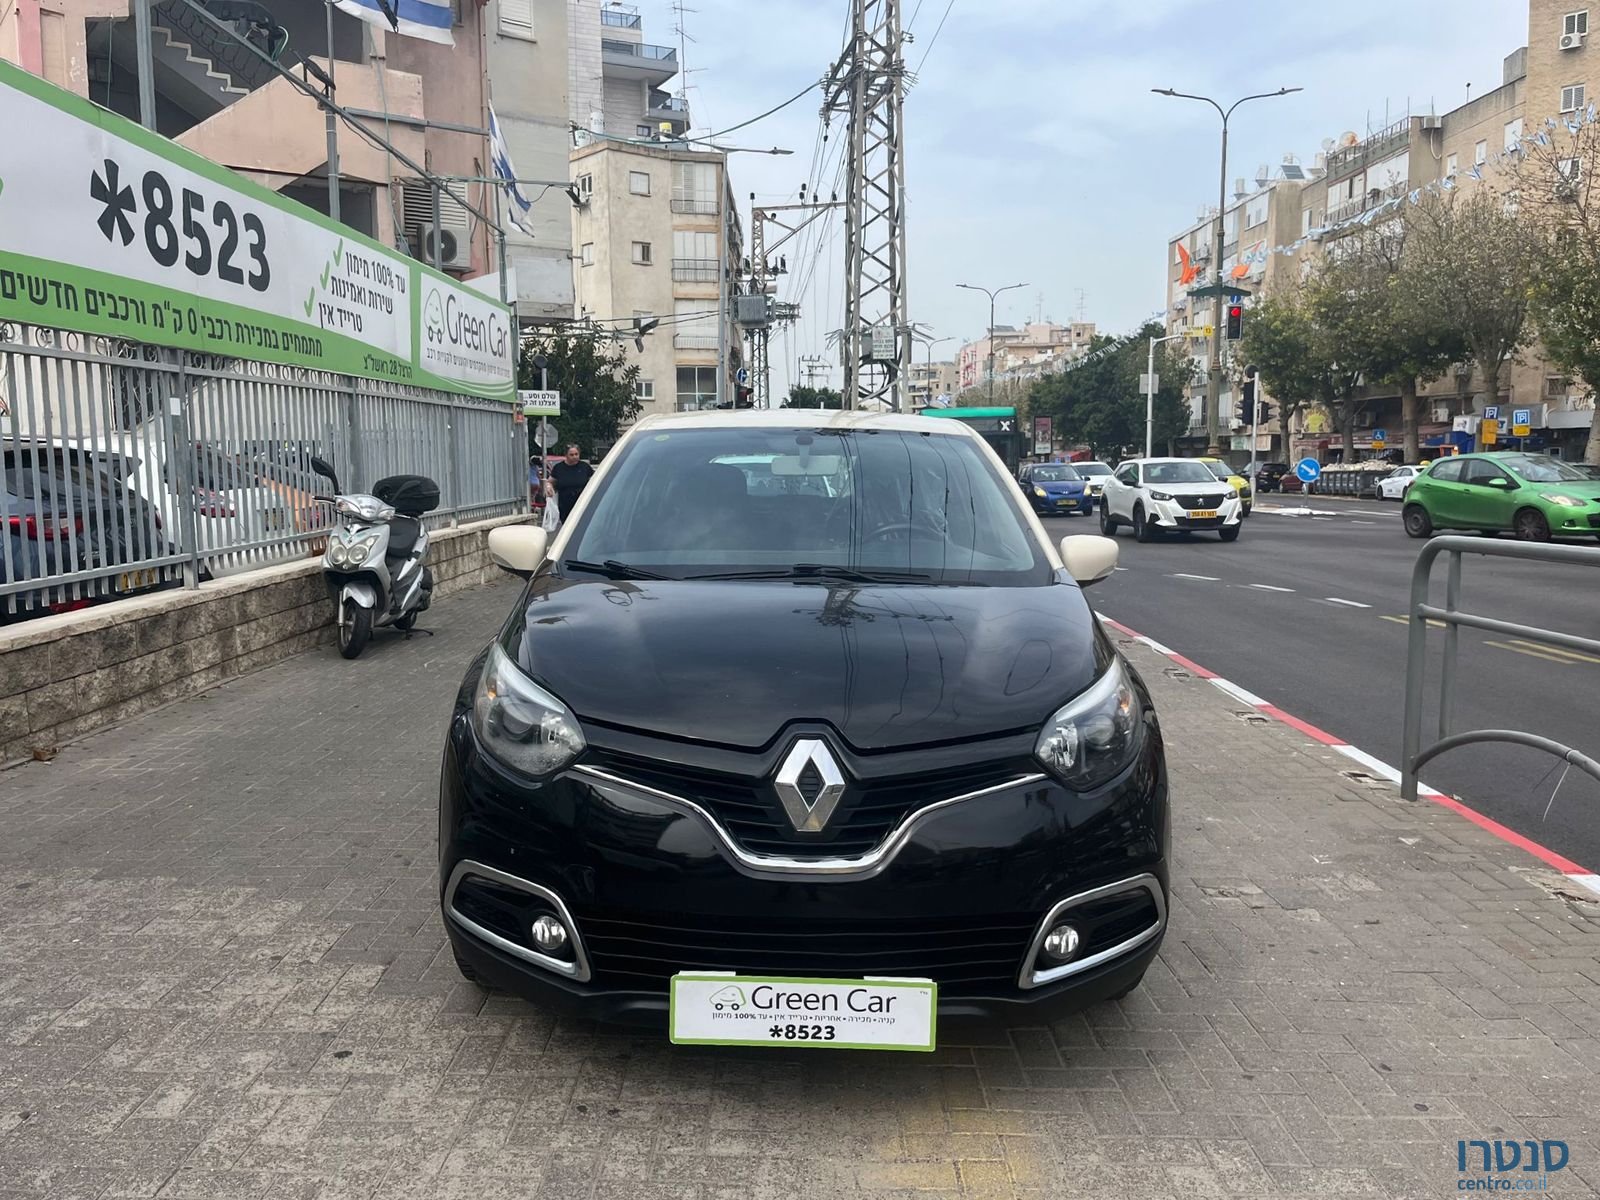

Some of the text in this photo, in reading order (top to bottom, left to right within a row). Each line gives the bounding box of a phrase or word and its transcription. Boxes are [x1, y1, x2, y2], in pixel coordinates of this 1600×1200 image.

[345, 251, 405, 294] עד 100% מימון
[0, 269, 79, 312] חדשים
[331, 276, 393, 315] שירות ואמינות
[85, 287, 147, 325] ורכבים
[319, 302, 363, 333] טרייד אין
[201, 315, 232, 342] רכבי
[235, 322, 279, 350] במכירת
[446, 294, 508, 360] Green Car
[282, 331, 323, 358] מתמחים
[389, 359, 398, 376] 28
[751, 985, 897, 1013] Green Car
[712, 1012, 732, 1020] מימון
[878, 1016, 895, 1025] קניה
